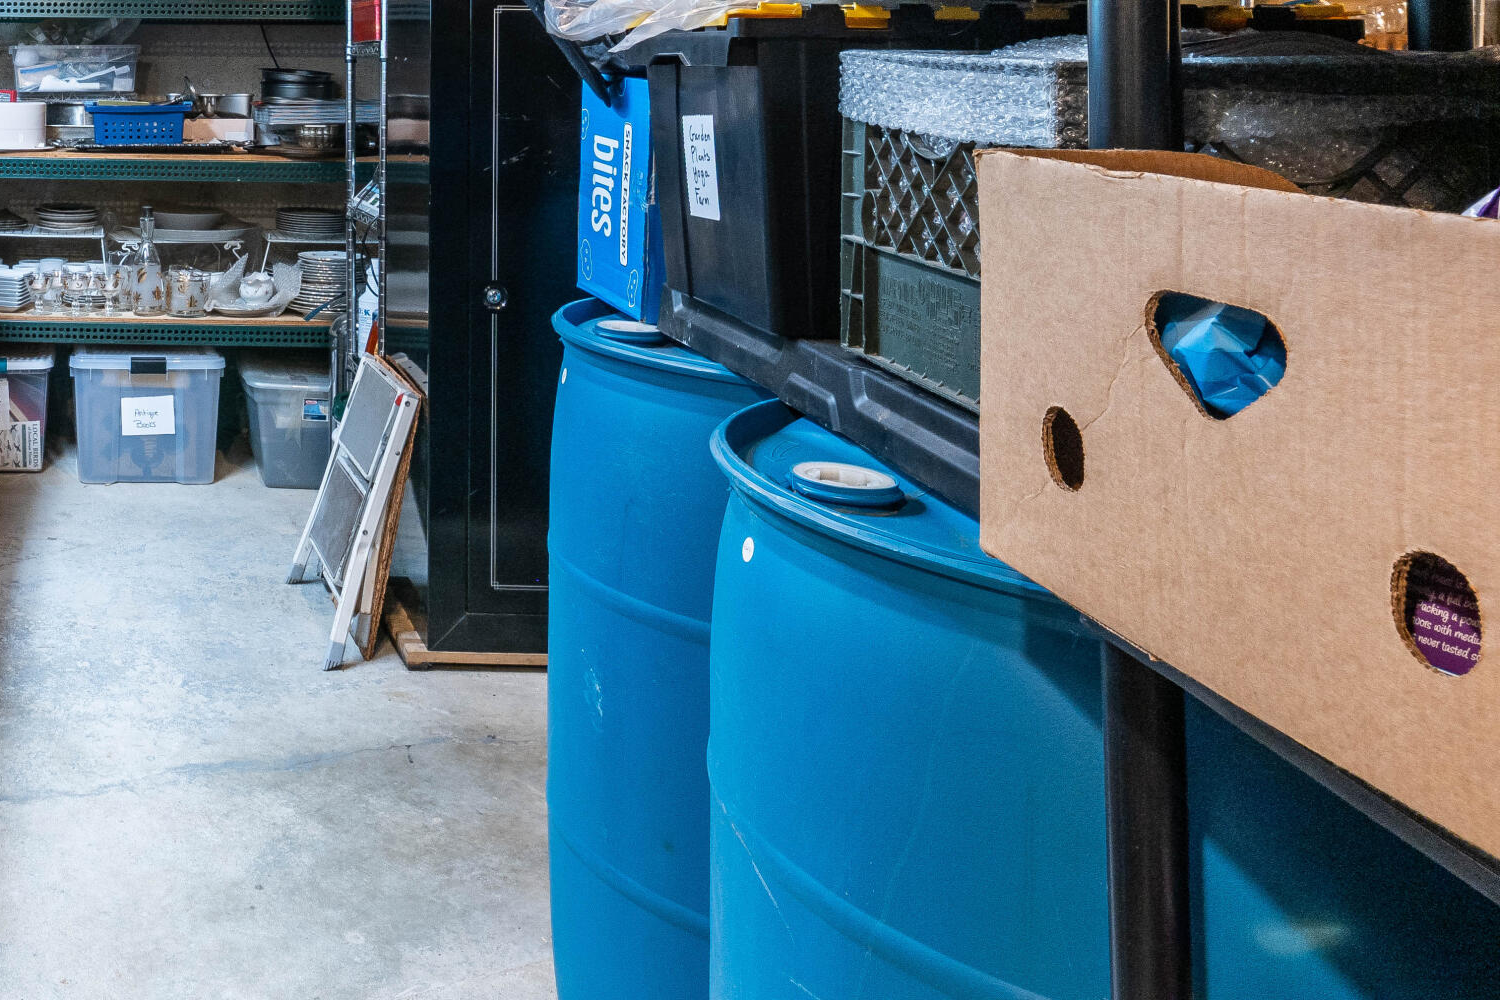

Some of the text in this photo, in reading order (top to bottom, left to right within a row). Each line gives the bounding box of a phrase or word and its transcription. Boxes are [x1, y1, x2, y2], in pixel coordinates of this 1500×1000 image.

[689, 125, 711, 142] Garden
[591, 134, 619, 238] bites
[621, 129, 631, 259] SNACK FACTORY
[1451, 613, 1458, 622] a
[1433, 624, 1482, 645] with medi
[1418, 634, 1470, 659] never tasted
